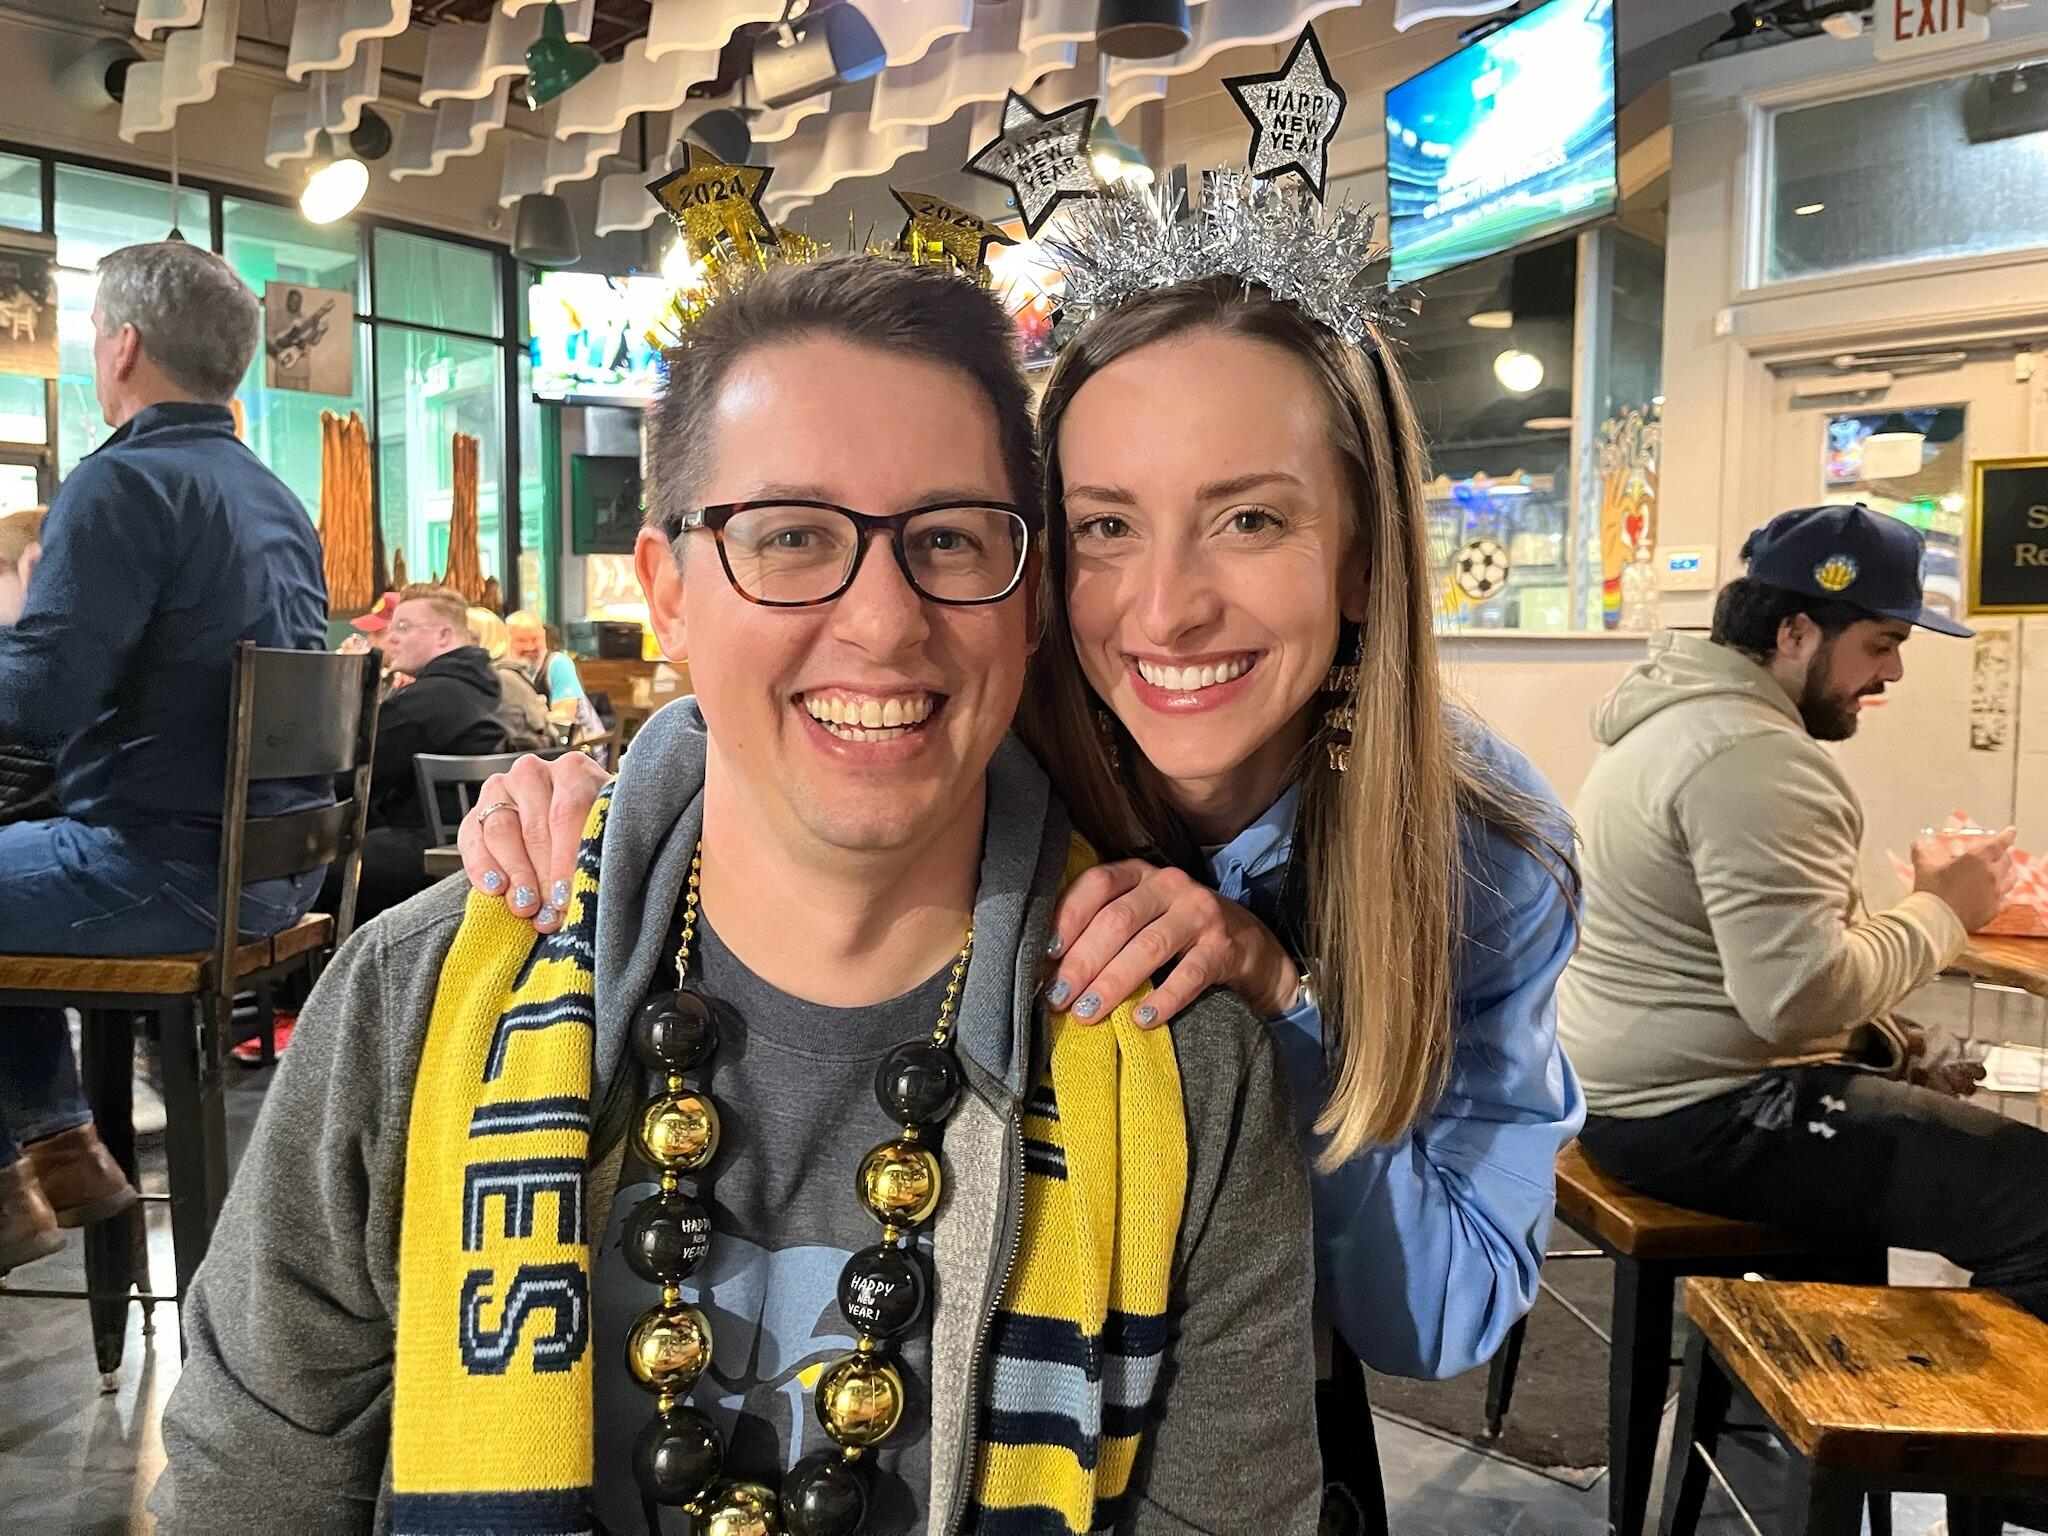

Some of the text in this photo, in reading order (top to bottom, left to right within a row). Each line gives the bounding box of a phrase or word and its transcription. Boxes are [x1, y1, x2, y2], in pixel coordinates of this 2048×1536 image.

[1266, 88, 1333, 115] HAPPY
[1273, 114, 1321, 135] NEW
[1018, 143, 1062, 177] NEW
[1023, 157, 1078, 191] YEAR
[680, 175, 746, 210] 2024
[851, 1275, 895, 1296] HAPPY
[848, 1303, 880, 1320] YEAR!
[857, 1294, 875, 1305] NEW
